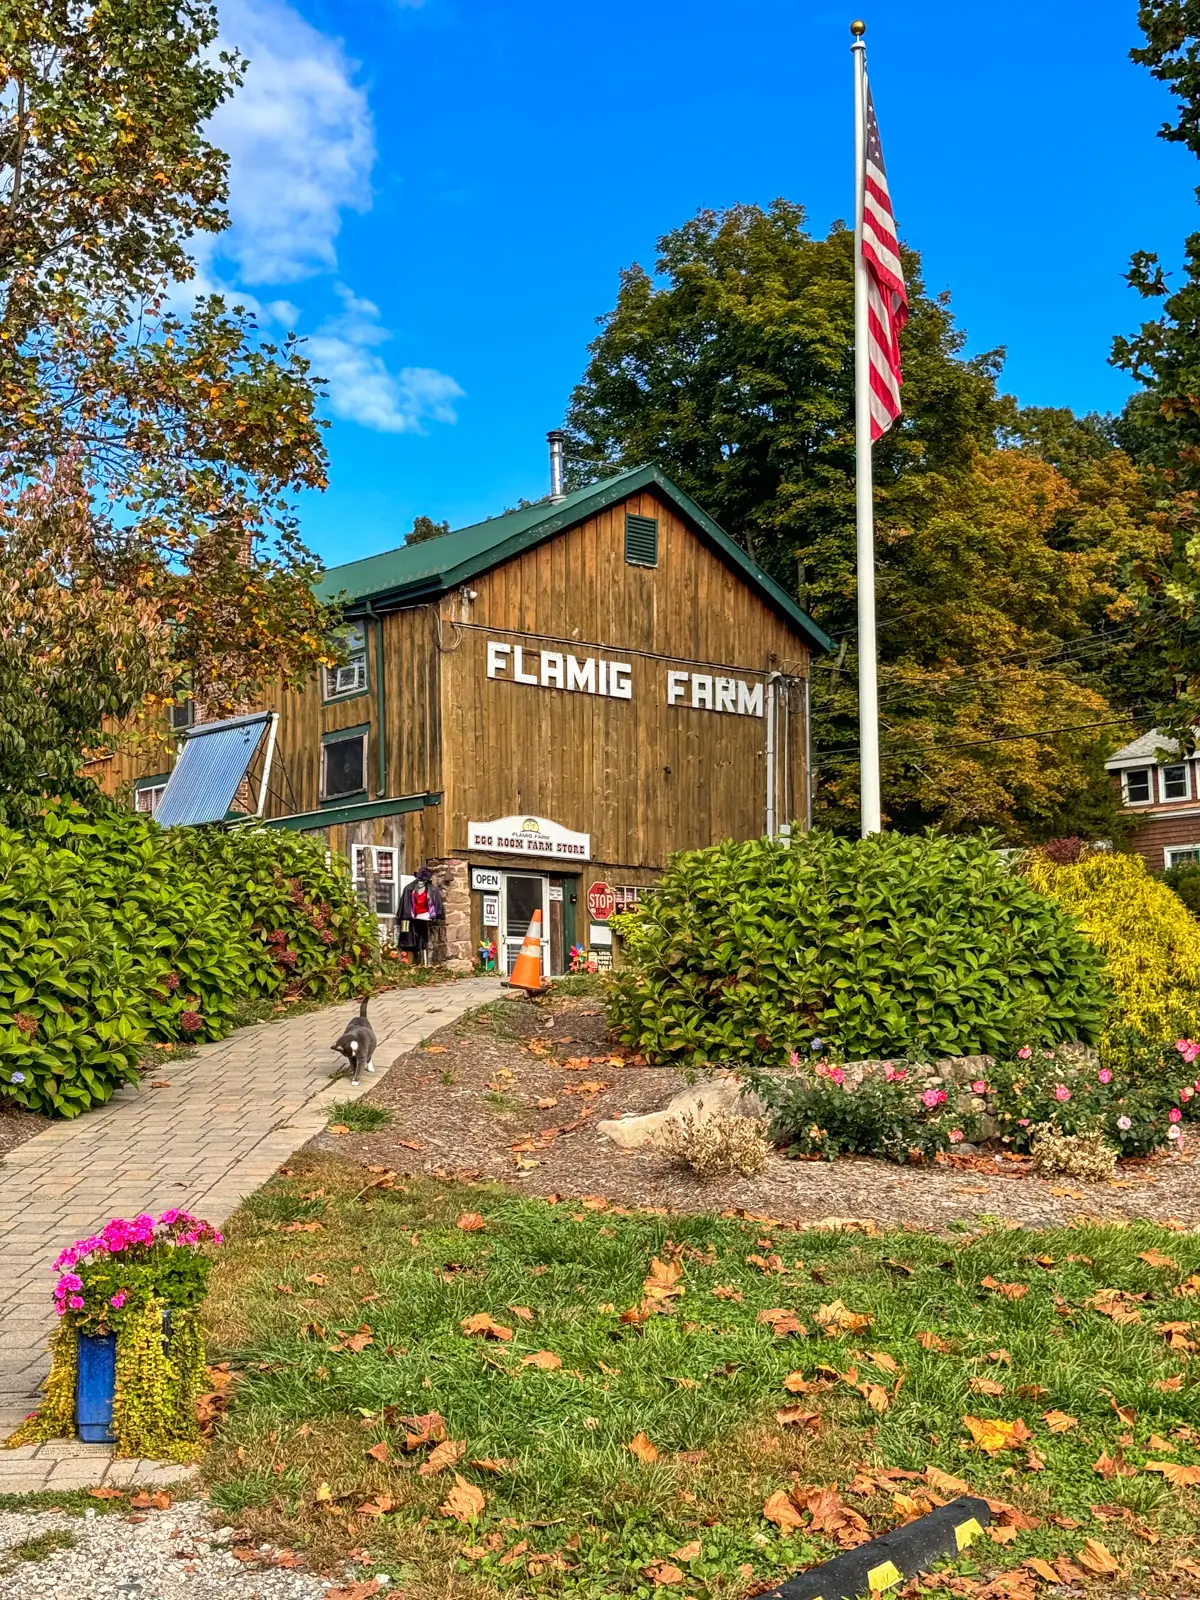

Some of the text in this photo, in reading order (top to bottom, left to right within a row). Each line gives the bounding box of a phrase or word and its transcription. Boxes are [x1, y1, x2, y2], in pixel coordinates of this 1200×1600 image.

[487, 641, 764, 718] FLAMIG FARM
[474, 835, 585, 855] EGG ROOM FARM STORE
[476, 874, 498, 885] OPEN
[589, 893, 613, 909] STOP
